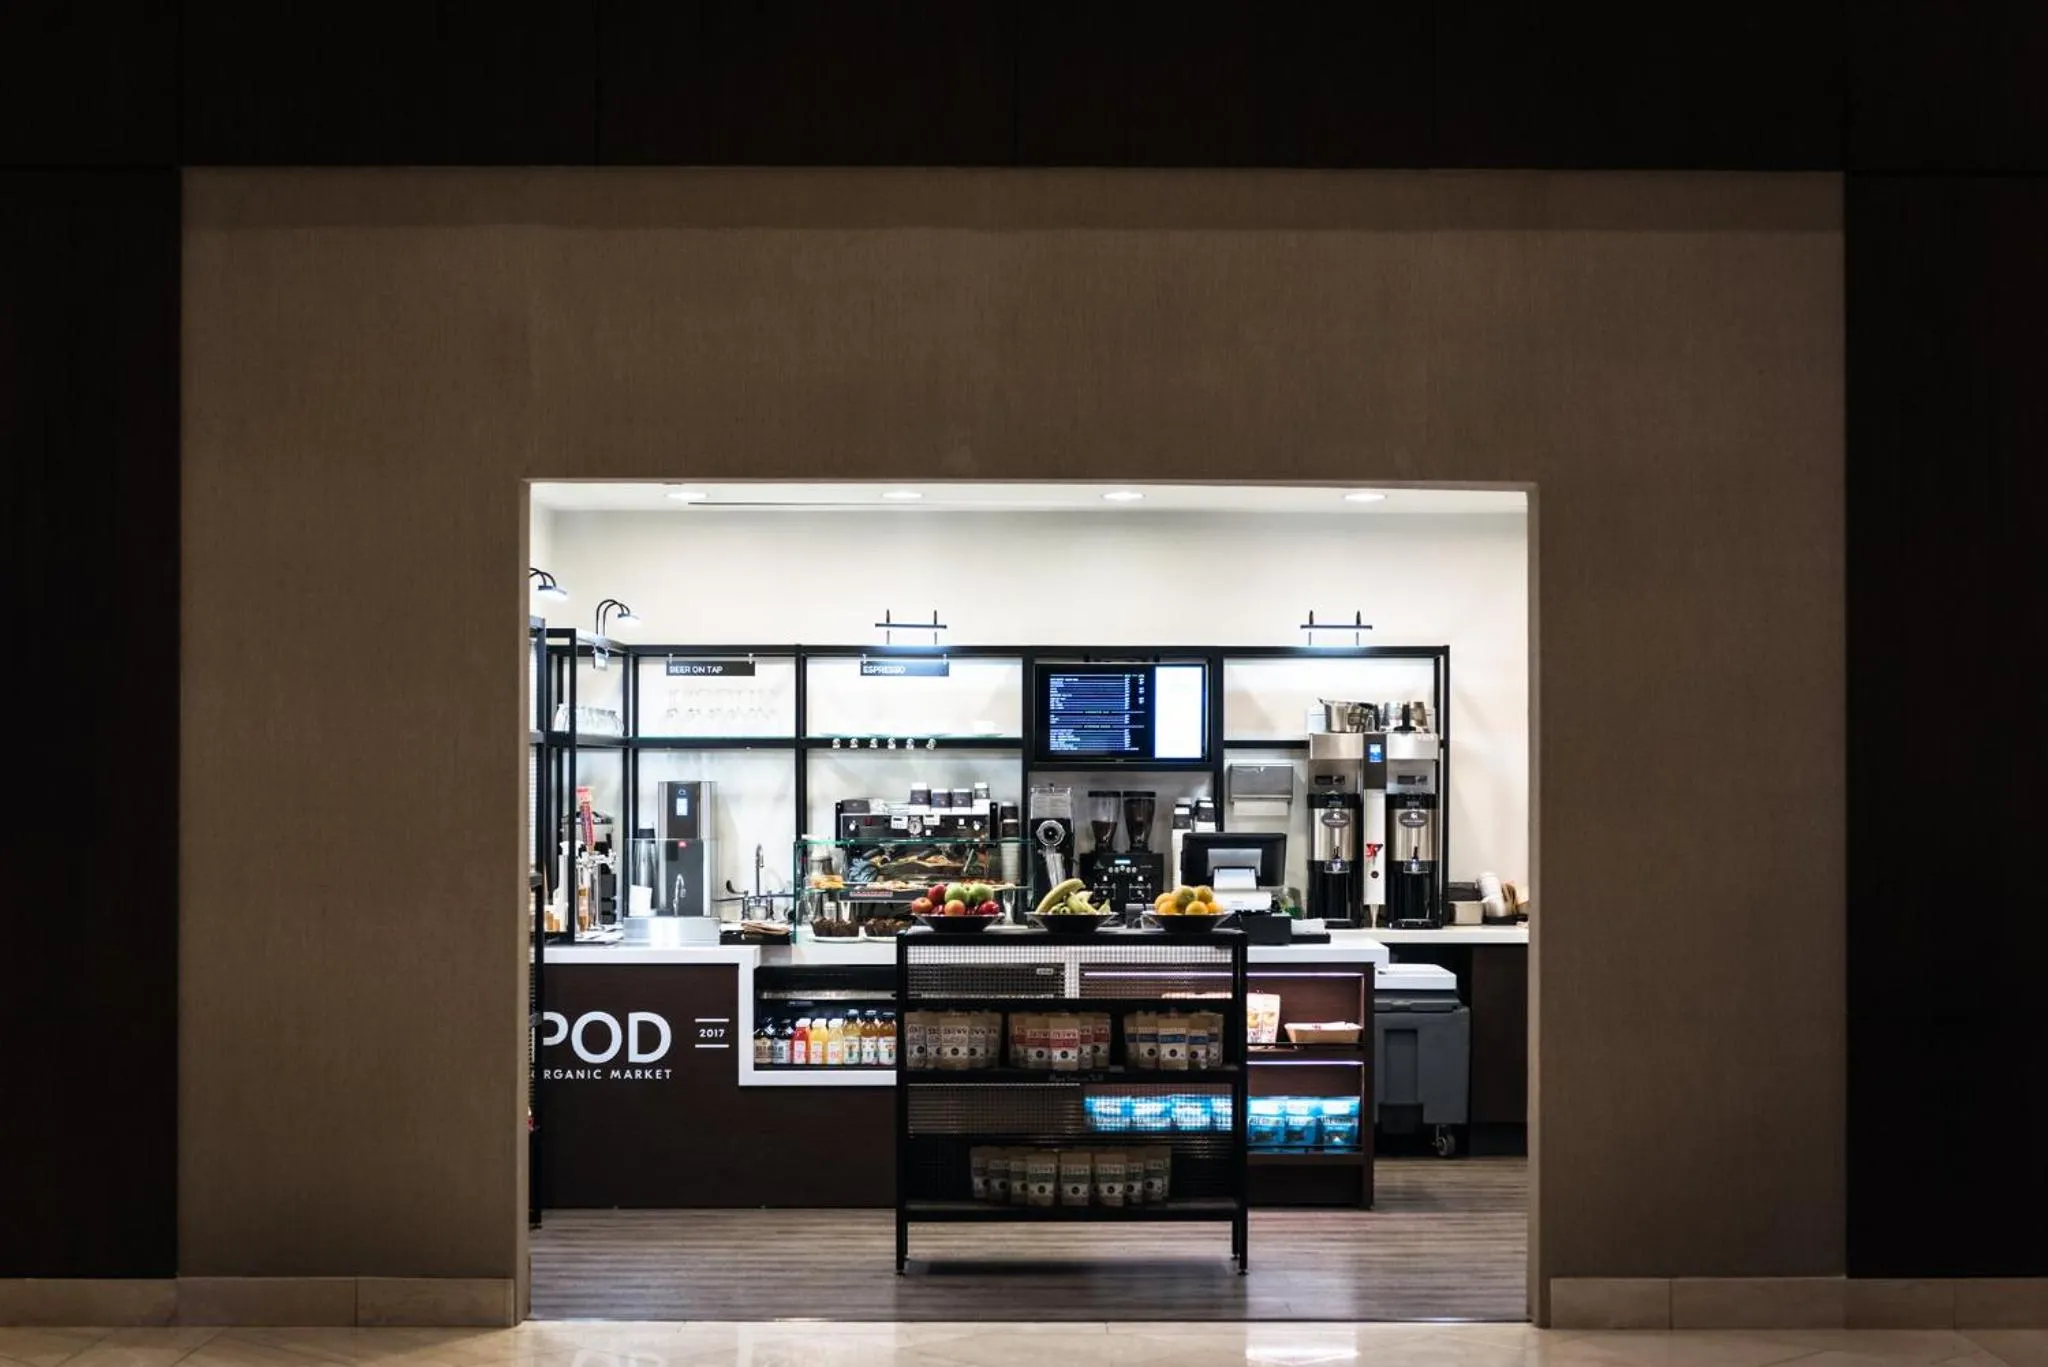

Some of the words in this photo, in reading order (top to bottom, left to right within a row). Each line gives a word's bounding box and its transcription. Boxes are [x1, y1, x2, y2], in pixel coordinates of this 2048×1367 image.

[669, 666, 690, 674] BEER
[692, 666, 705, 674] ON
[706, 666, 723, 674] TAP
[863, 666, 905, 674] ESPRESSO
[531, 1011, 672, 1064] POD
[699, 1029, 725, 1038] 2017
[531, 1069, 602, 1080] RGANIC
[610, 1069, 672, 1080] MARKET
